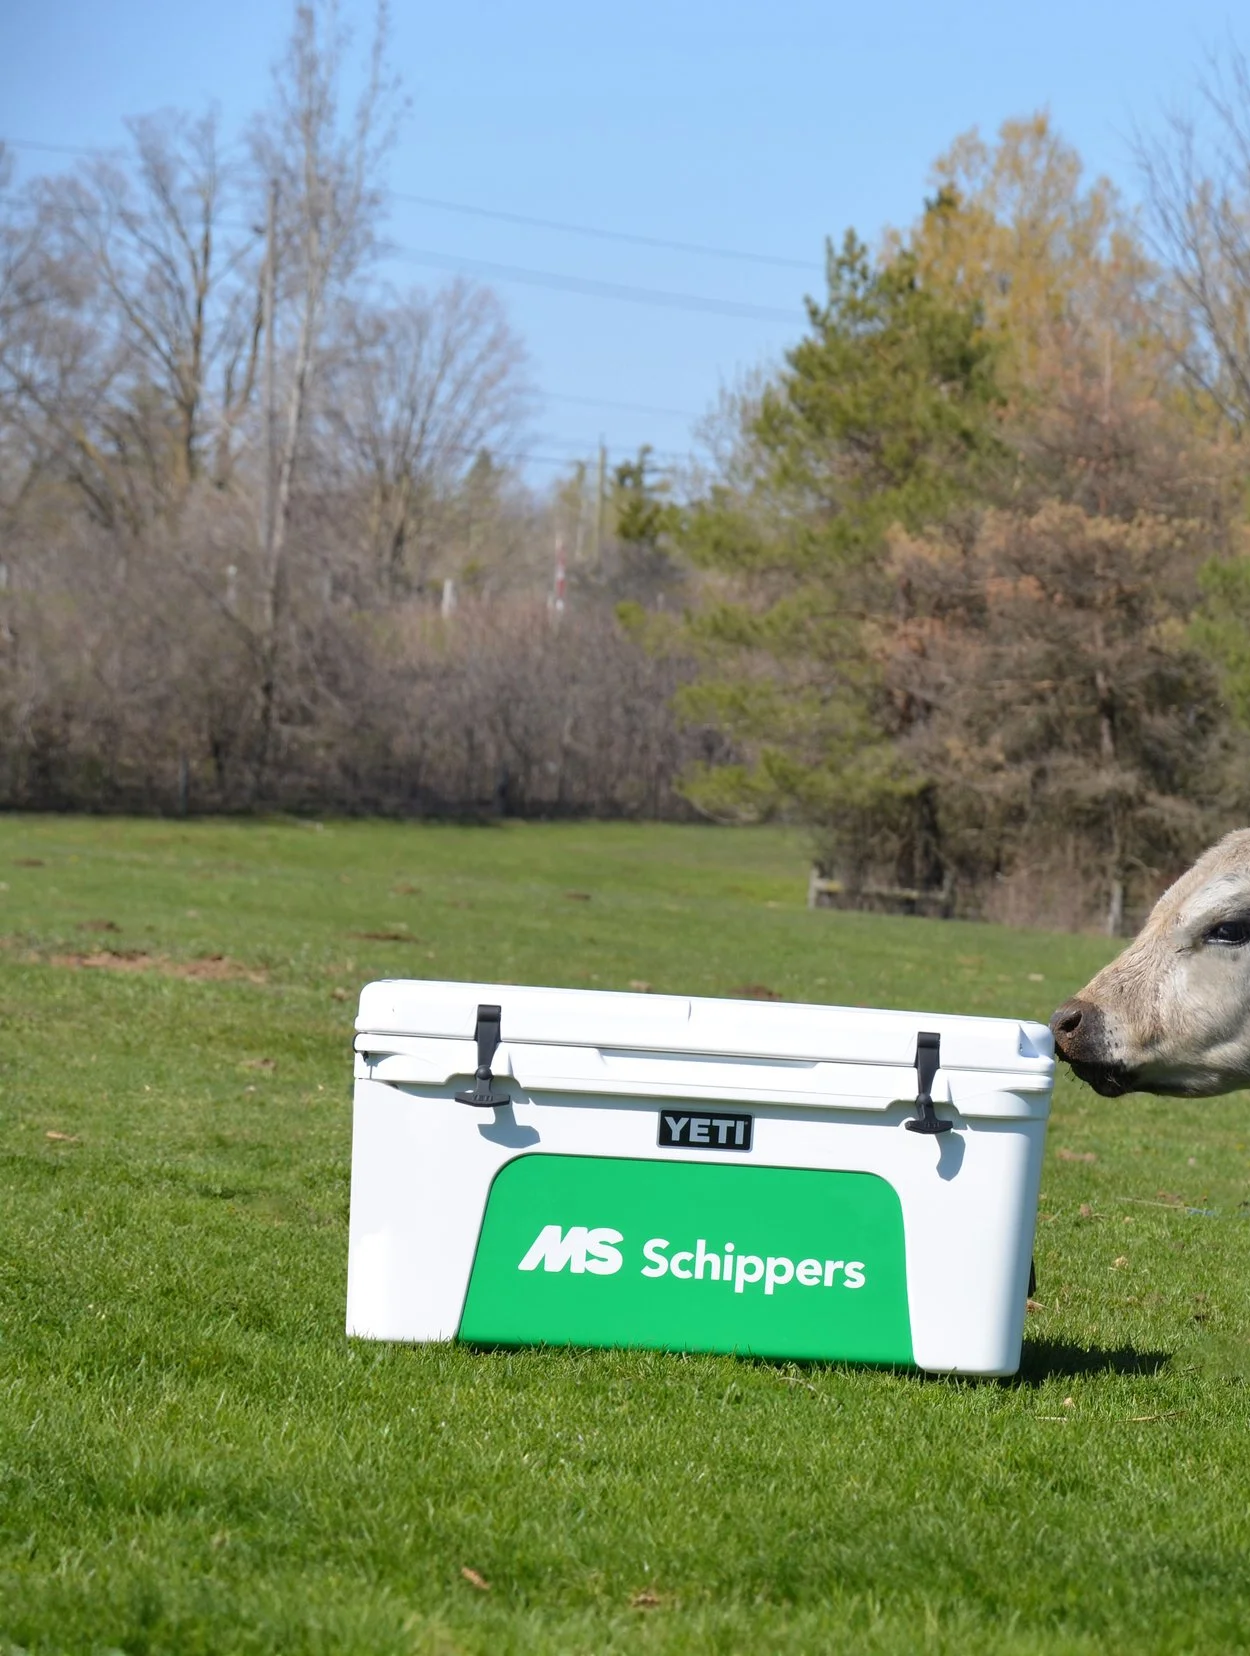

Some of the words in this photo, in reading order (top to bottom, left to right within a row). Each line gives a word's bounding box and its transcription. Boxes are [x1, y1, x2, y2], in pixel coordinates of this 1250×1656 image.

[664, 1116, 745, 1145] YETI
[517, 1224, 624, 1276] MS
[640, 1238, 866, 1295] Schippers
